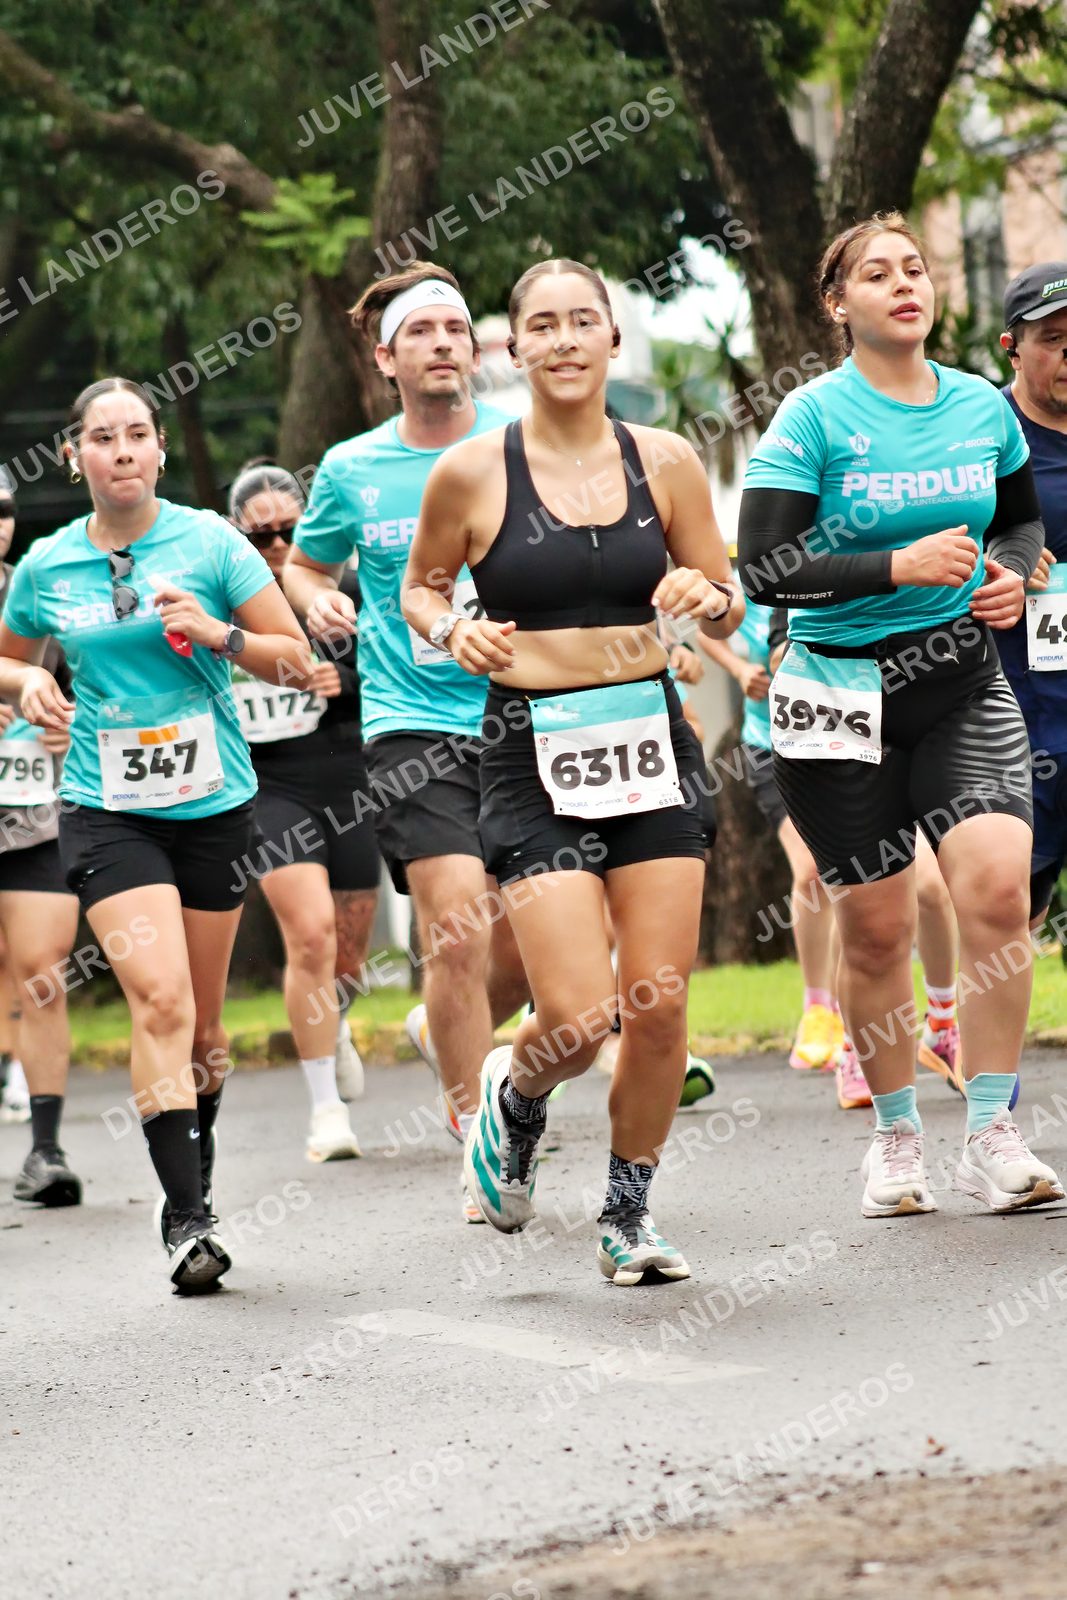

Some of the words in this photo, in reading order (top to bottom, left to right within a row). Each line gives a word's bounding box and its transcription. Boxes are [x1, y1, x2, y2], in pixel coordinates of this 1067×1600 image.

[798, 590, 835, 600] SPORT
[773, 694, 872, 739] 3976
[122, 738, 198, 782] 347
[550, 739, 665, 791] 6318
